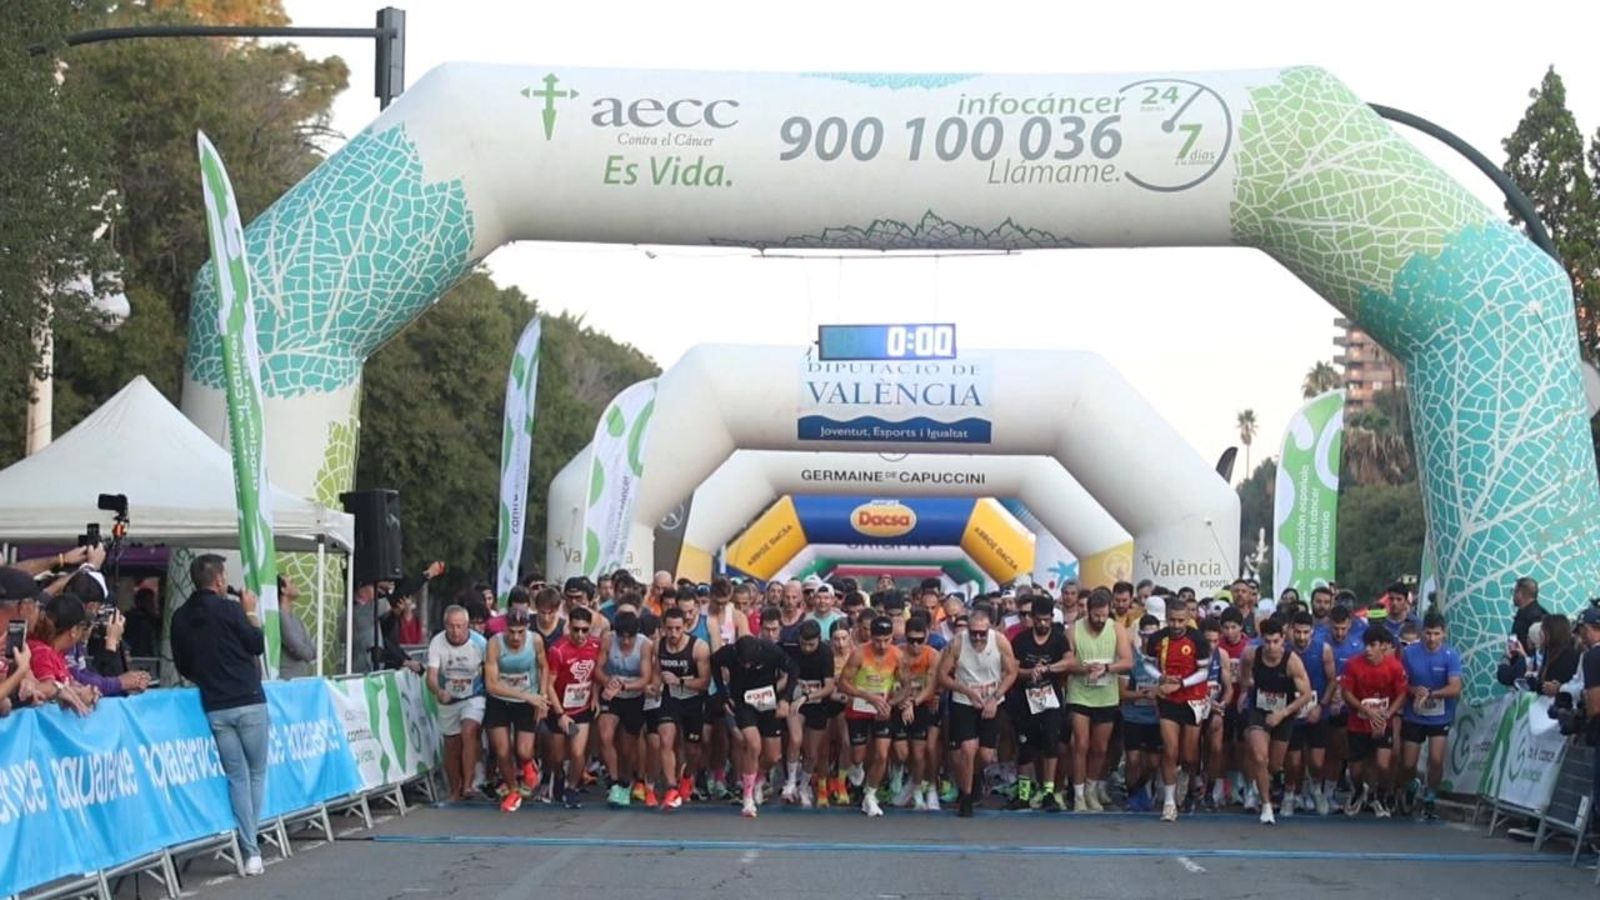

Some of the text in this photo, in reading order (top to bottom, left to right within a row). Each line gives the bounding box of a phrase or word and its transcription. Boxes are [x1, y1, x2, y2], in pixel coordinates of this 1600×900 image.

[957, 92, 1126, 115] infocáncer
[1141, 86, 1179, 105] 24
[591, 97, 740, 129] aecc
[617, 132, 714, 147] Contra el Cáncer
[779, 114, 1123, 162] 900 100 036
[1177, 123, 1202, 159] 7
[603, 155, 733, 187] Es Vida.
[988, 158, 1121, 185] Llámame.
[887, 326, 953, 358] 0:00
[952, 364, 981, 376] DE
[807, 377, 983, 407] VALÈNCIA
[820, 425, 870, 437] Joventut,
[873, 426, 916, 439] Esports
[927, 428, 968, 440] Igualtat
[801, 469, 884, 482] GERMAINE
[899, 471, 986, 484] CAPUCCINI
[859, 511, 910, 526] Dacsa
[1151, 559, 1221, 576] València
